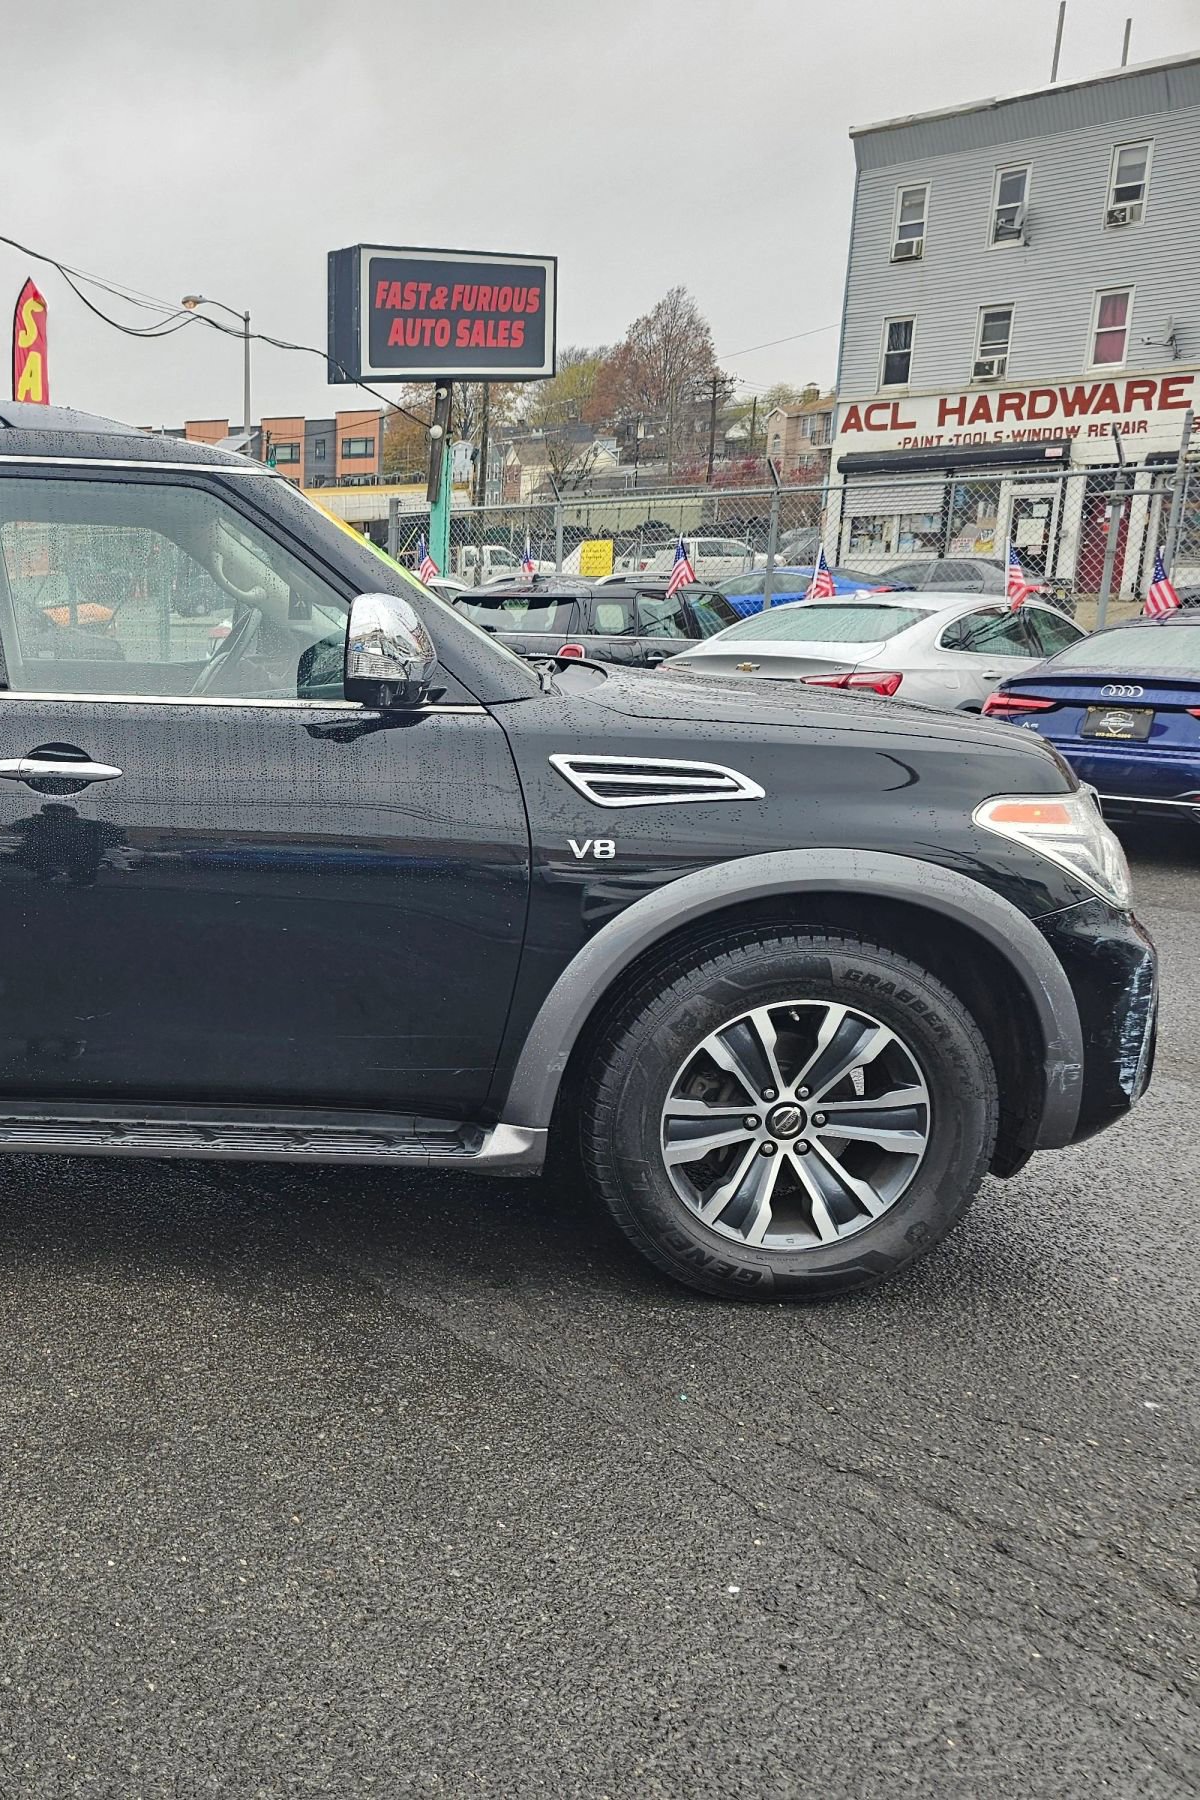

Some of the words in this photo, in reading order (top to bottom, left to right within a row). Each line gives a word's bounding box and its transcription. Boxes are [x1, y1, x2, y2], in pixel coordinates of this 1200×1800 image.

[375, 280, 432, 311] FAST
[450, 284, 541, 314] FURIOUS
[387, 317, 451, 348] AUTO
[455, 319, 526, 349] SALES
[840, 402, 917, 433] ACL
[936, 375, 1195, 427] HARDWARE
[1011, 424, 1081, 442] WINDOW
[566, 839, 616, 859] V8
